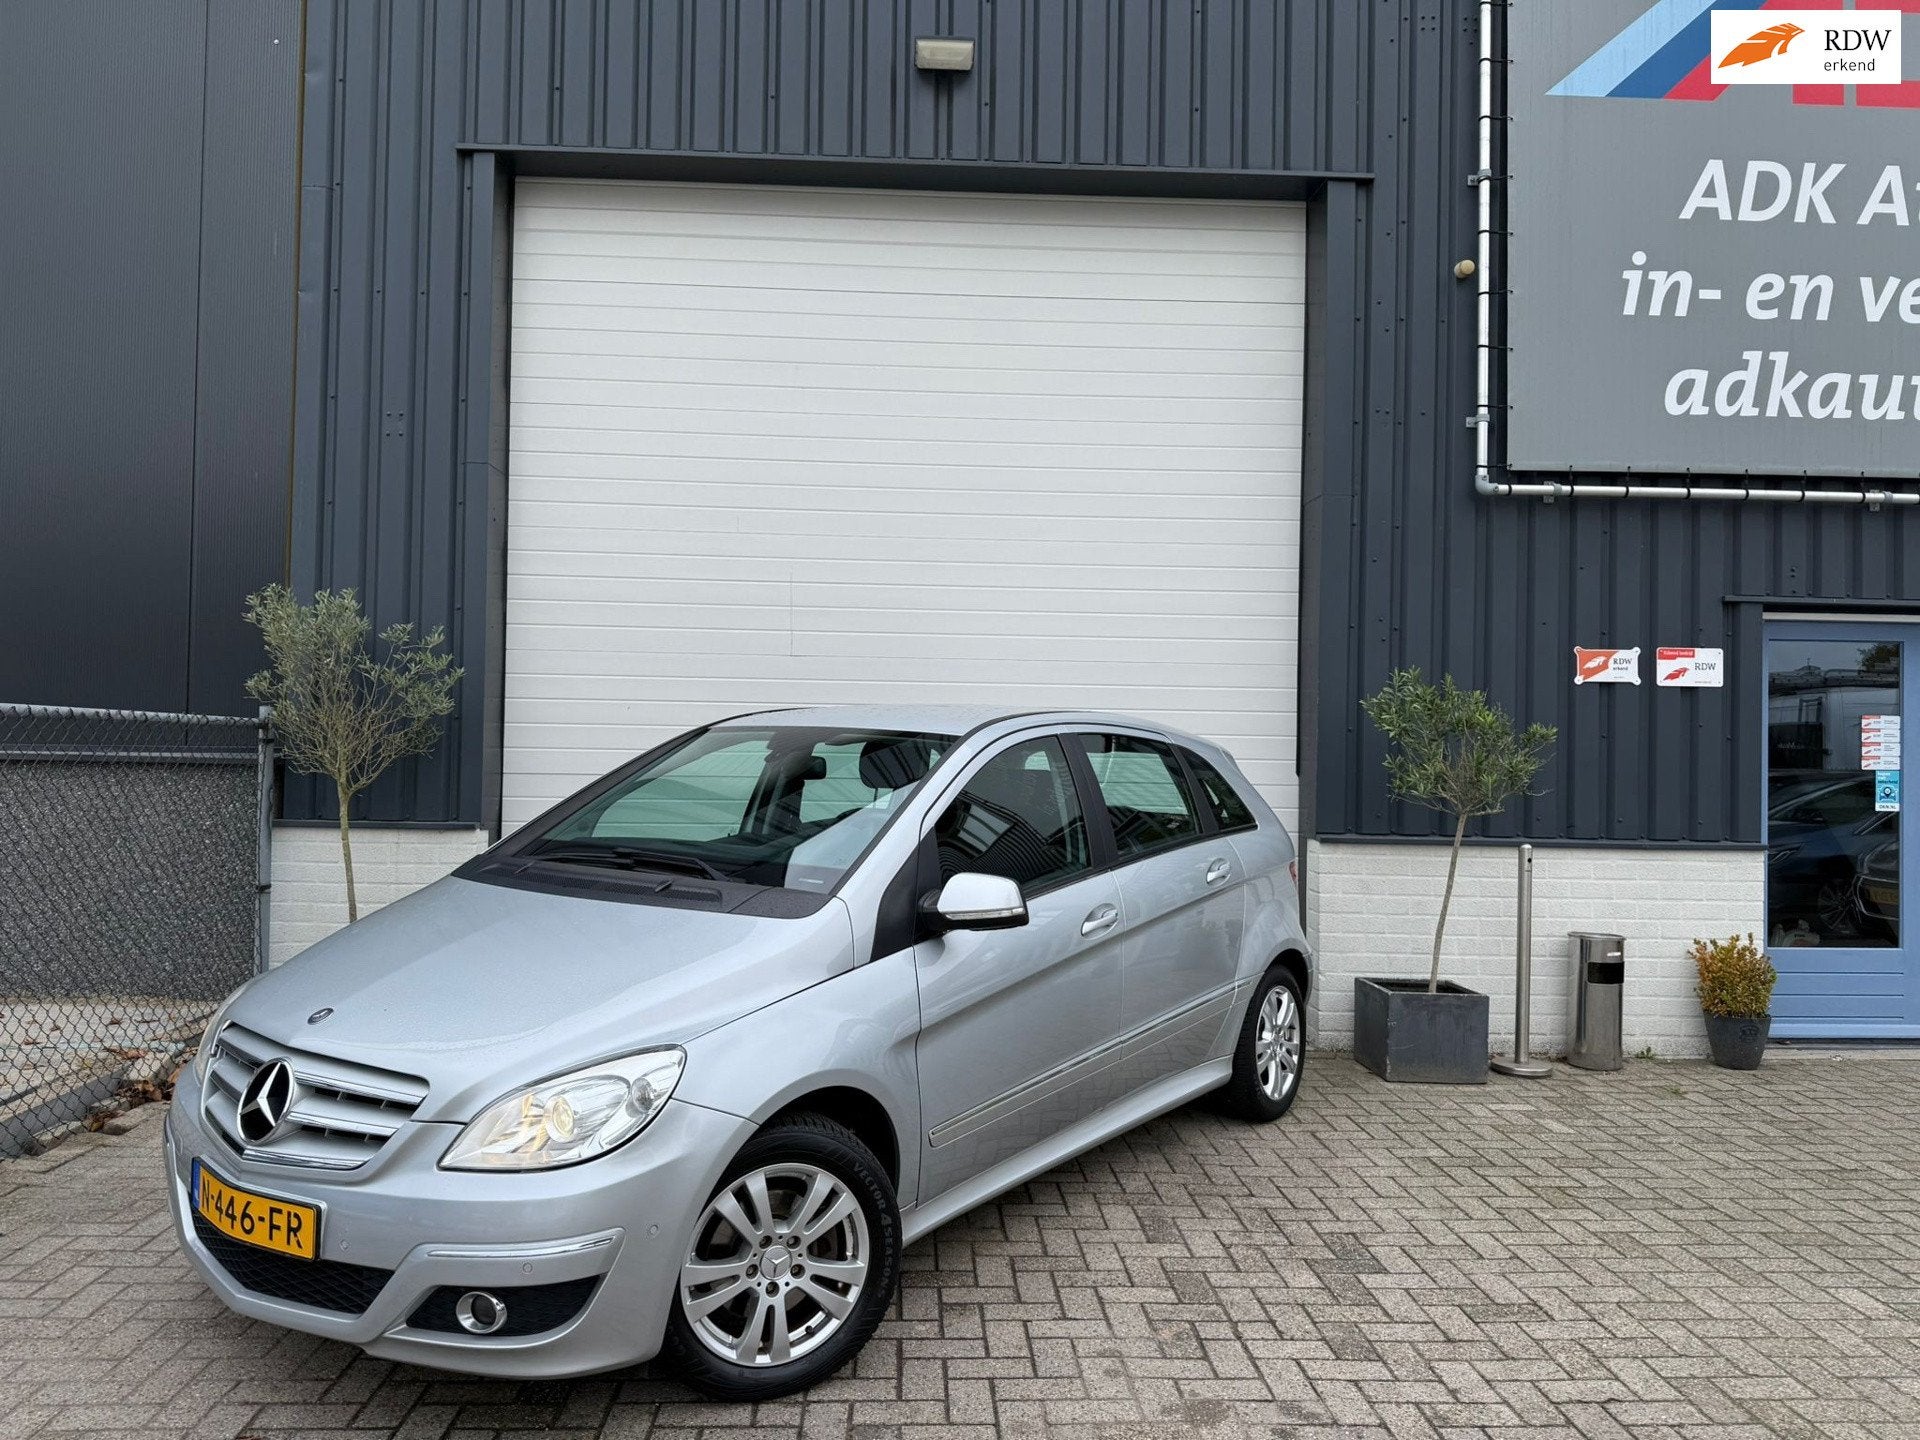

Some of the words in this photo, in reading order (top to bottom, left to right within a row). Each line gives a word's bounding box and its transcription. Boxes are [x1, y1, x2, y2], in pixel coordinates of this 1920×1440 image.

[1679, 158, 1846, 225] ADK
[1622, 250, 1722, 317] in-
[1745, 271, 1834, 321] en
[1613, 657, 1632, 665] RDW
[1694, 662, 1716, 671] RDW
[201, 1175, 304, 1250] N-446-FR
[853, 1161, 886, 1211] VECTOR
